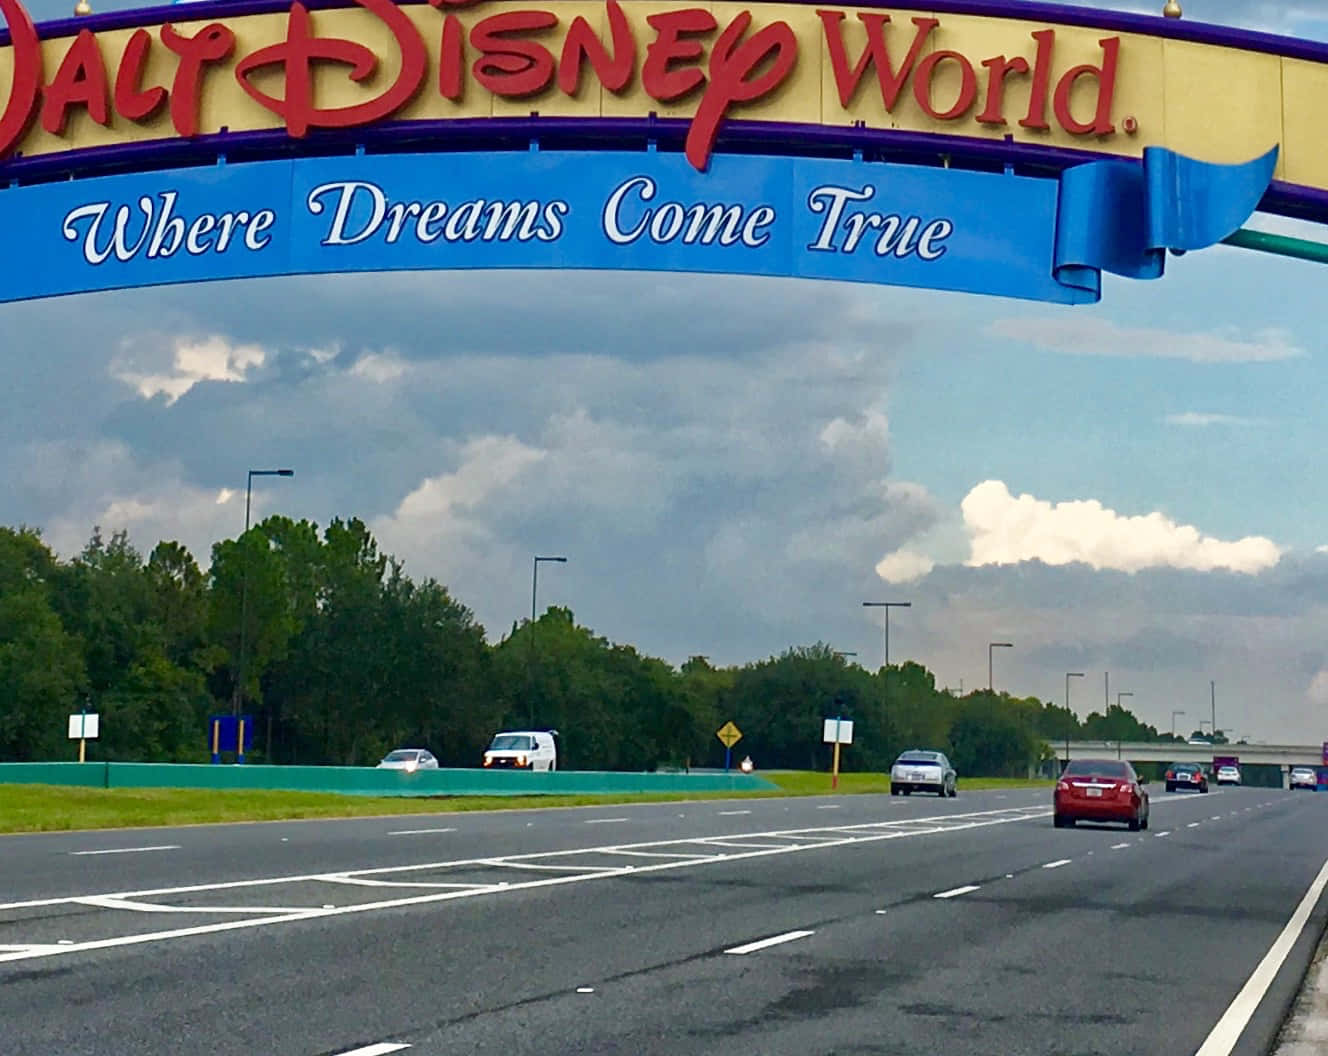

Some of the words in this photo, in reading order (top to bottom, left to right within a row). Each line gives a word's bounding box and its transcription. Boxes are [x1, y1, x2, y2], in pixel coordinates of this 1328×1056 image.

[64, 192, 274, 265] Where
[308, 180, 568, 247] Dreams
[603, 177, 775, 248] Come
[808, 184, 954, 259] True
